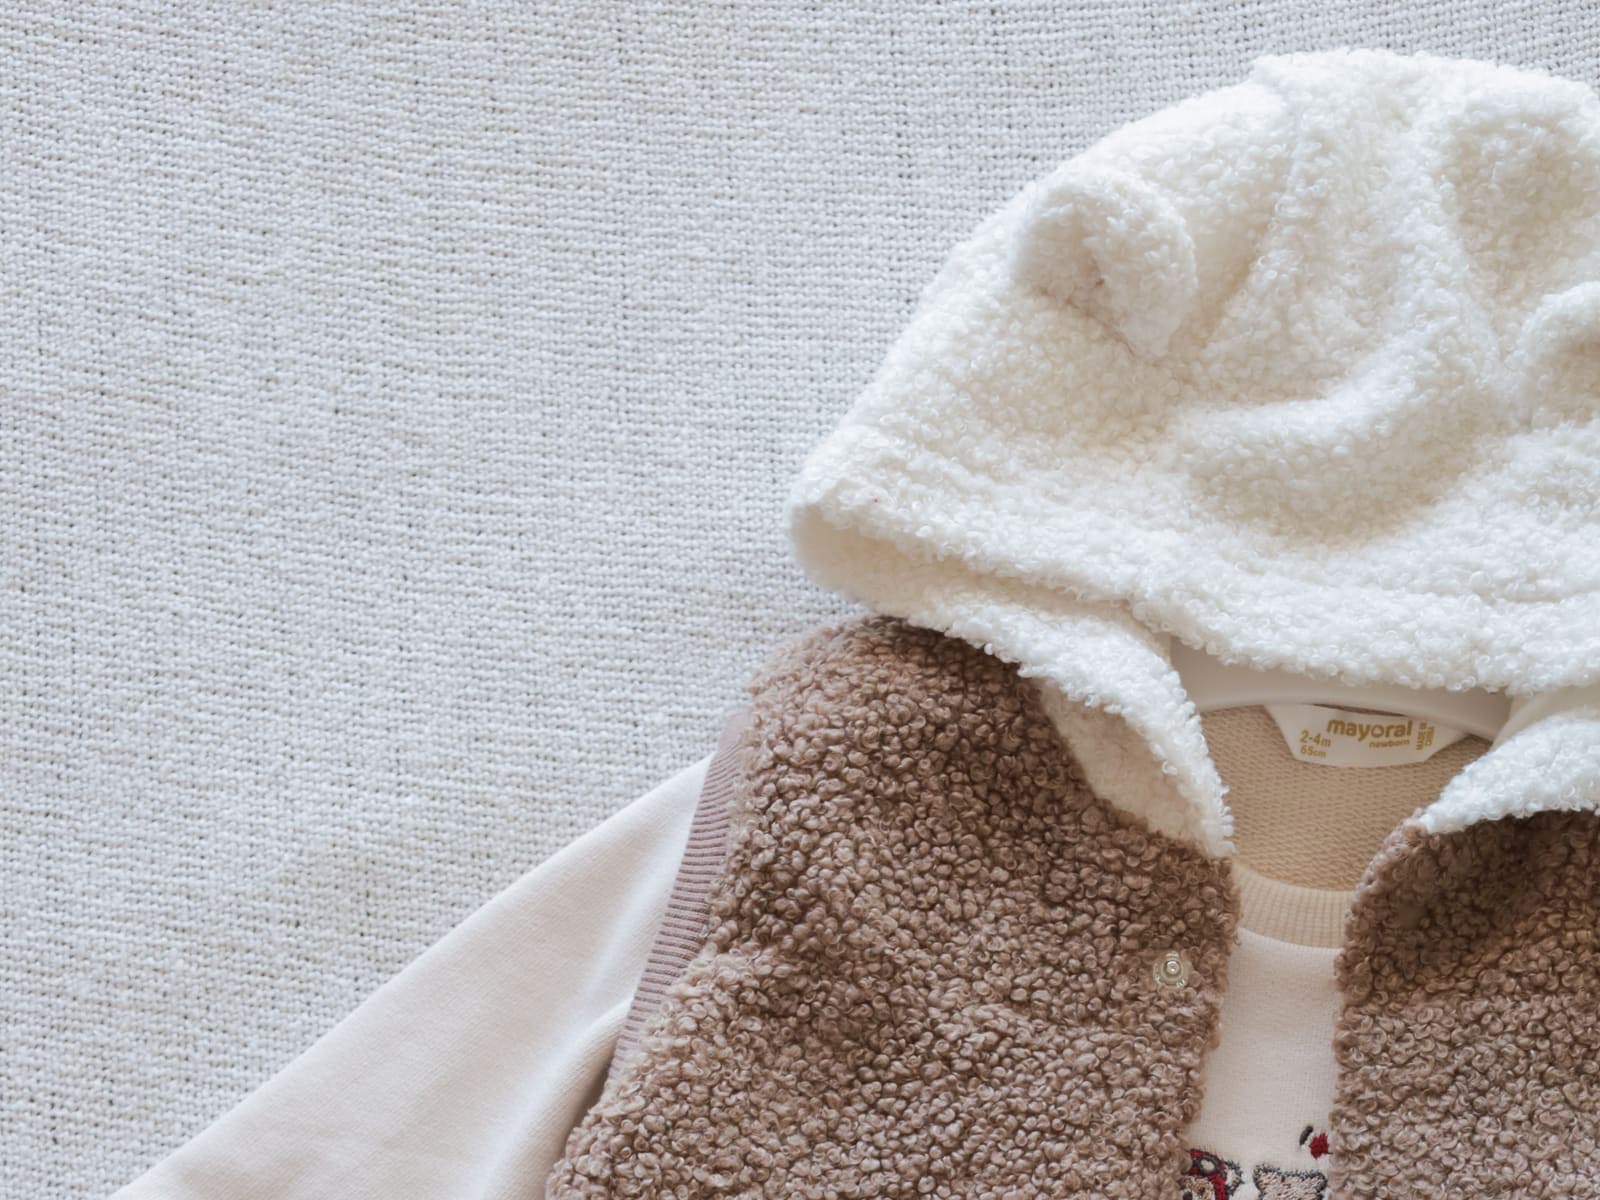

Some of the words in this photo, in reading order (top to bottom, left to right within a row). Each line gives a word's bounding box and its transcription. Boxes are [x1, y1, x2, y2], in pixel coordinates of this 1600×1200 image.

[1326, 719, 1413, 741] mayoral
[1300, 729, 1331, 747] 2-4m
[1369, 739, 1410, 748] newborn
[1300, 745, 1326, 757] 65cm
